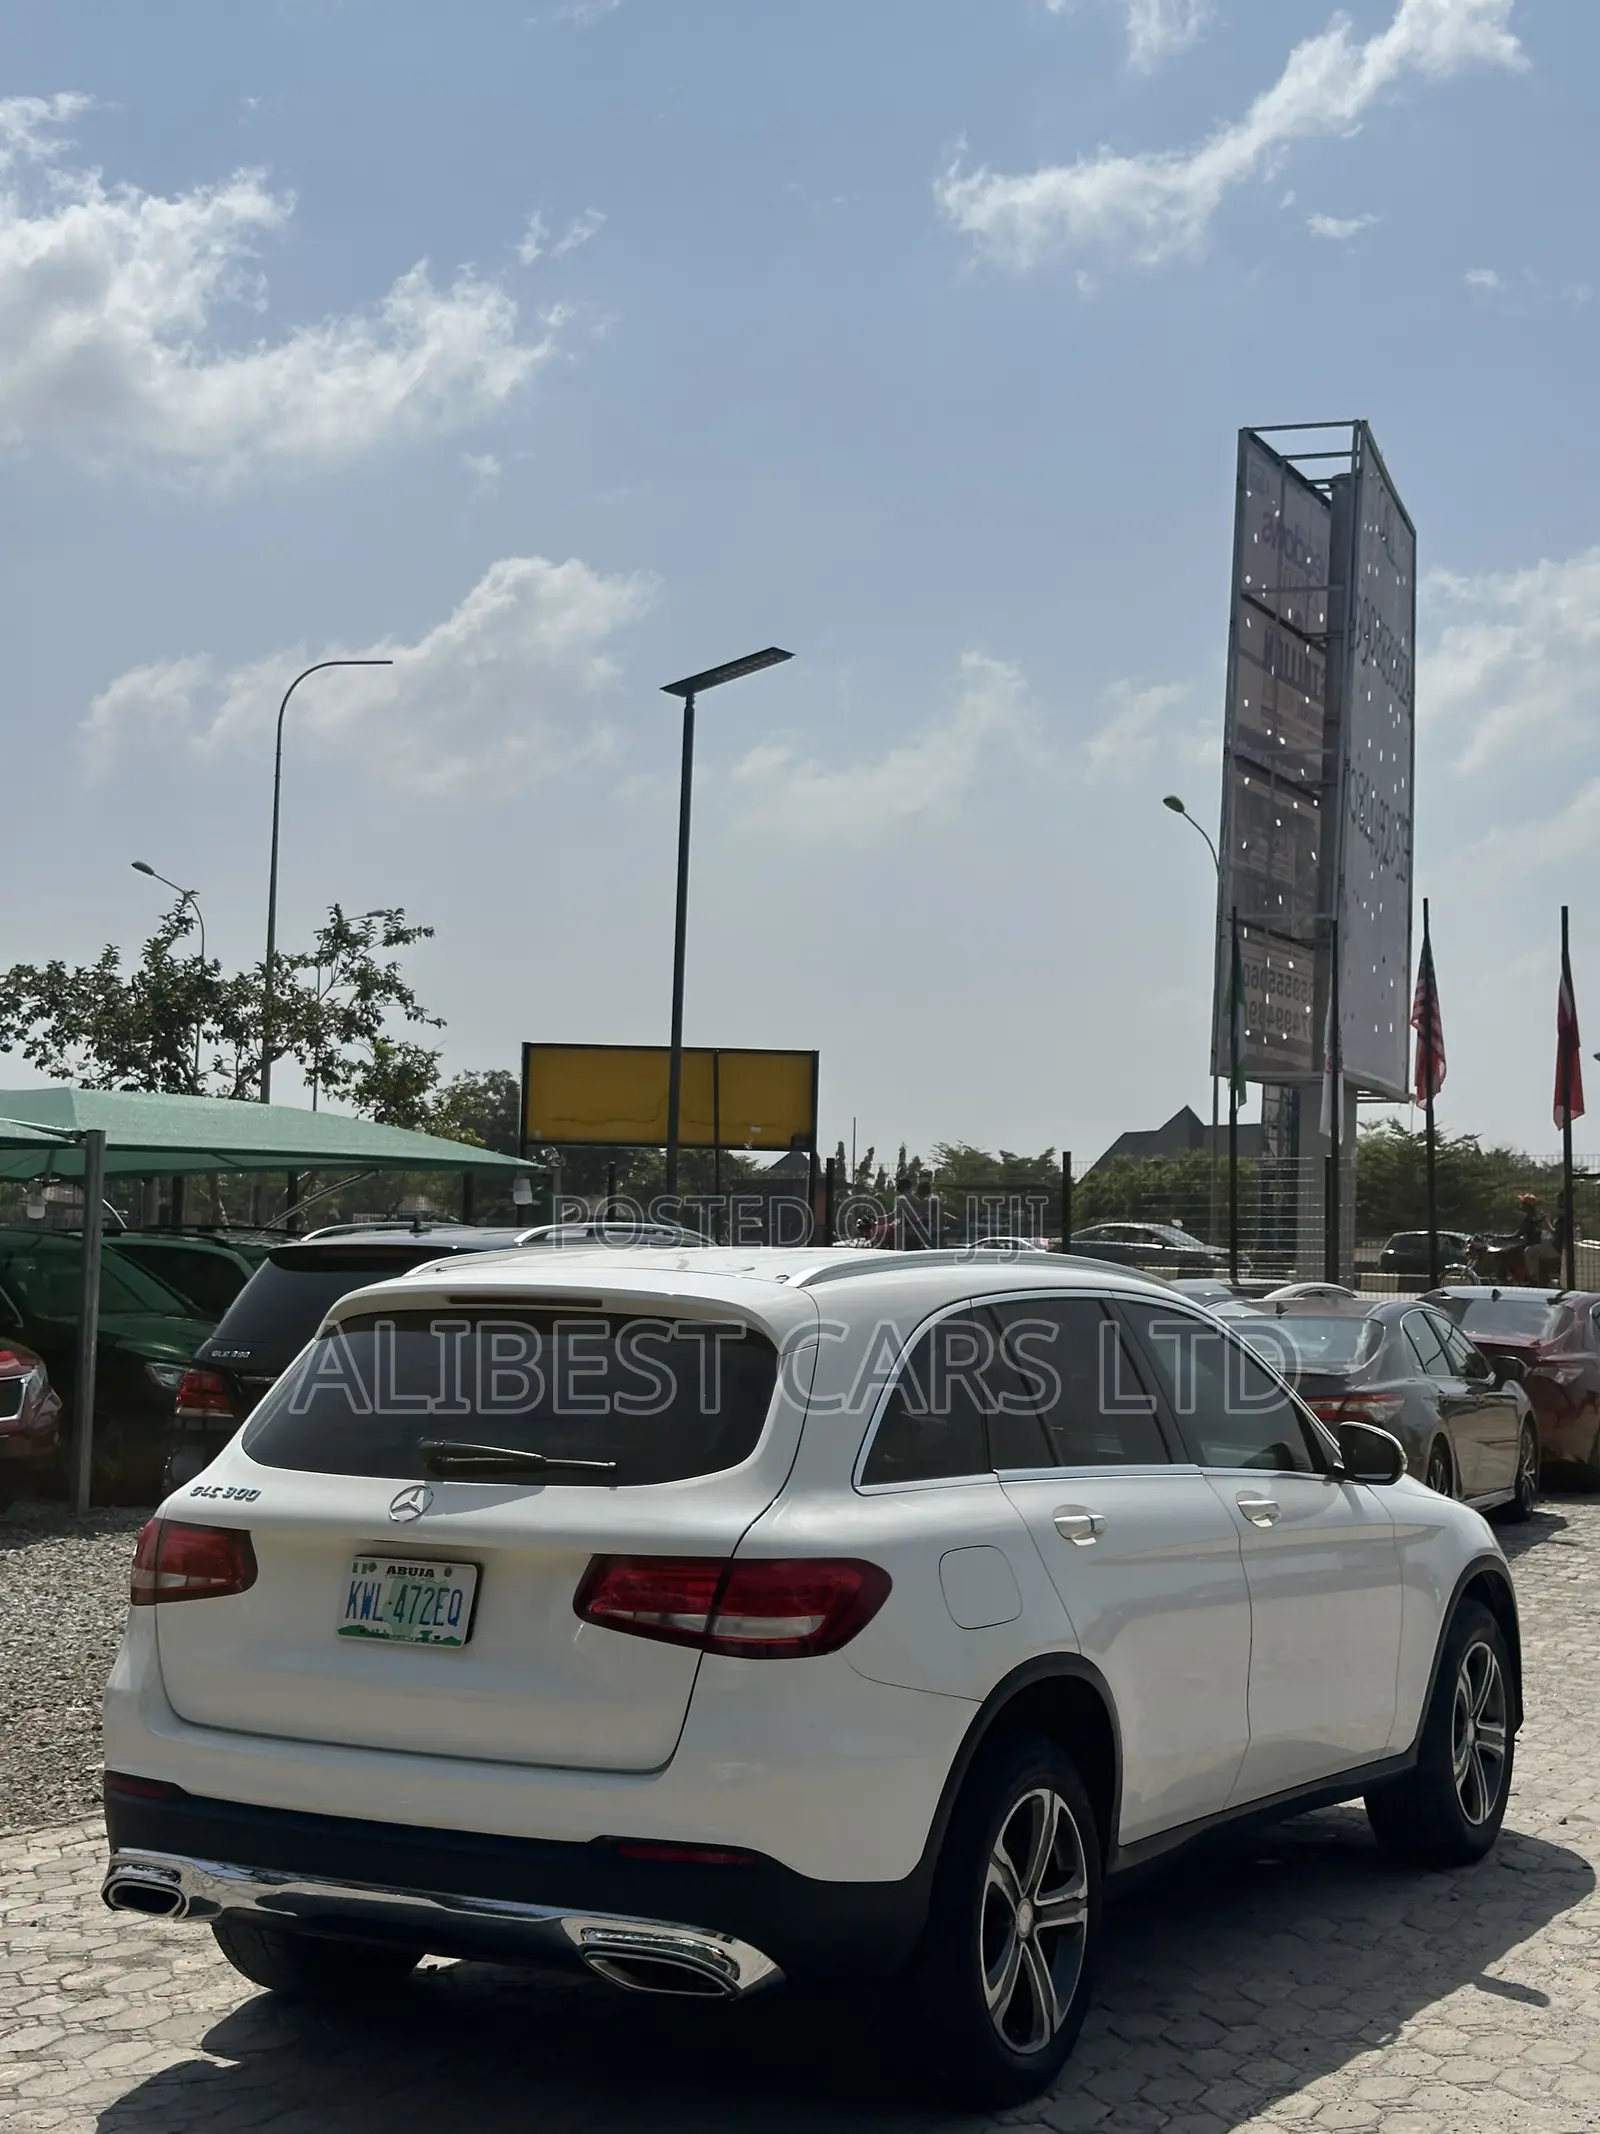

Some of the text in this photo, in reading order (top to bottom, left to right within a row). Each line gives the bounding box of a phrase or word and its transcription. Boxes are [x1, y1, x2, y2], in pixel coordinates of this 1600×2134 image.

[190, 1485, 262, 1503] GLC 300
[386, 1565, 435, 1578] ABUJA
